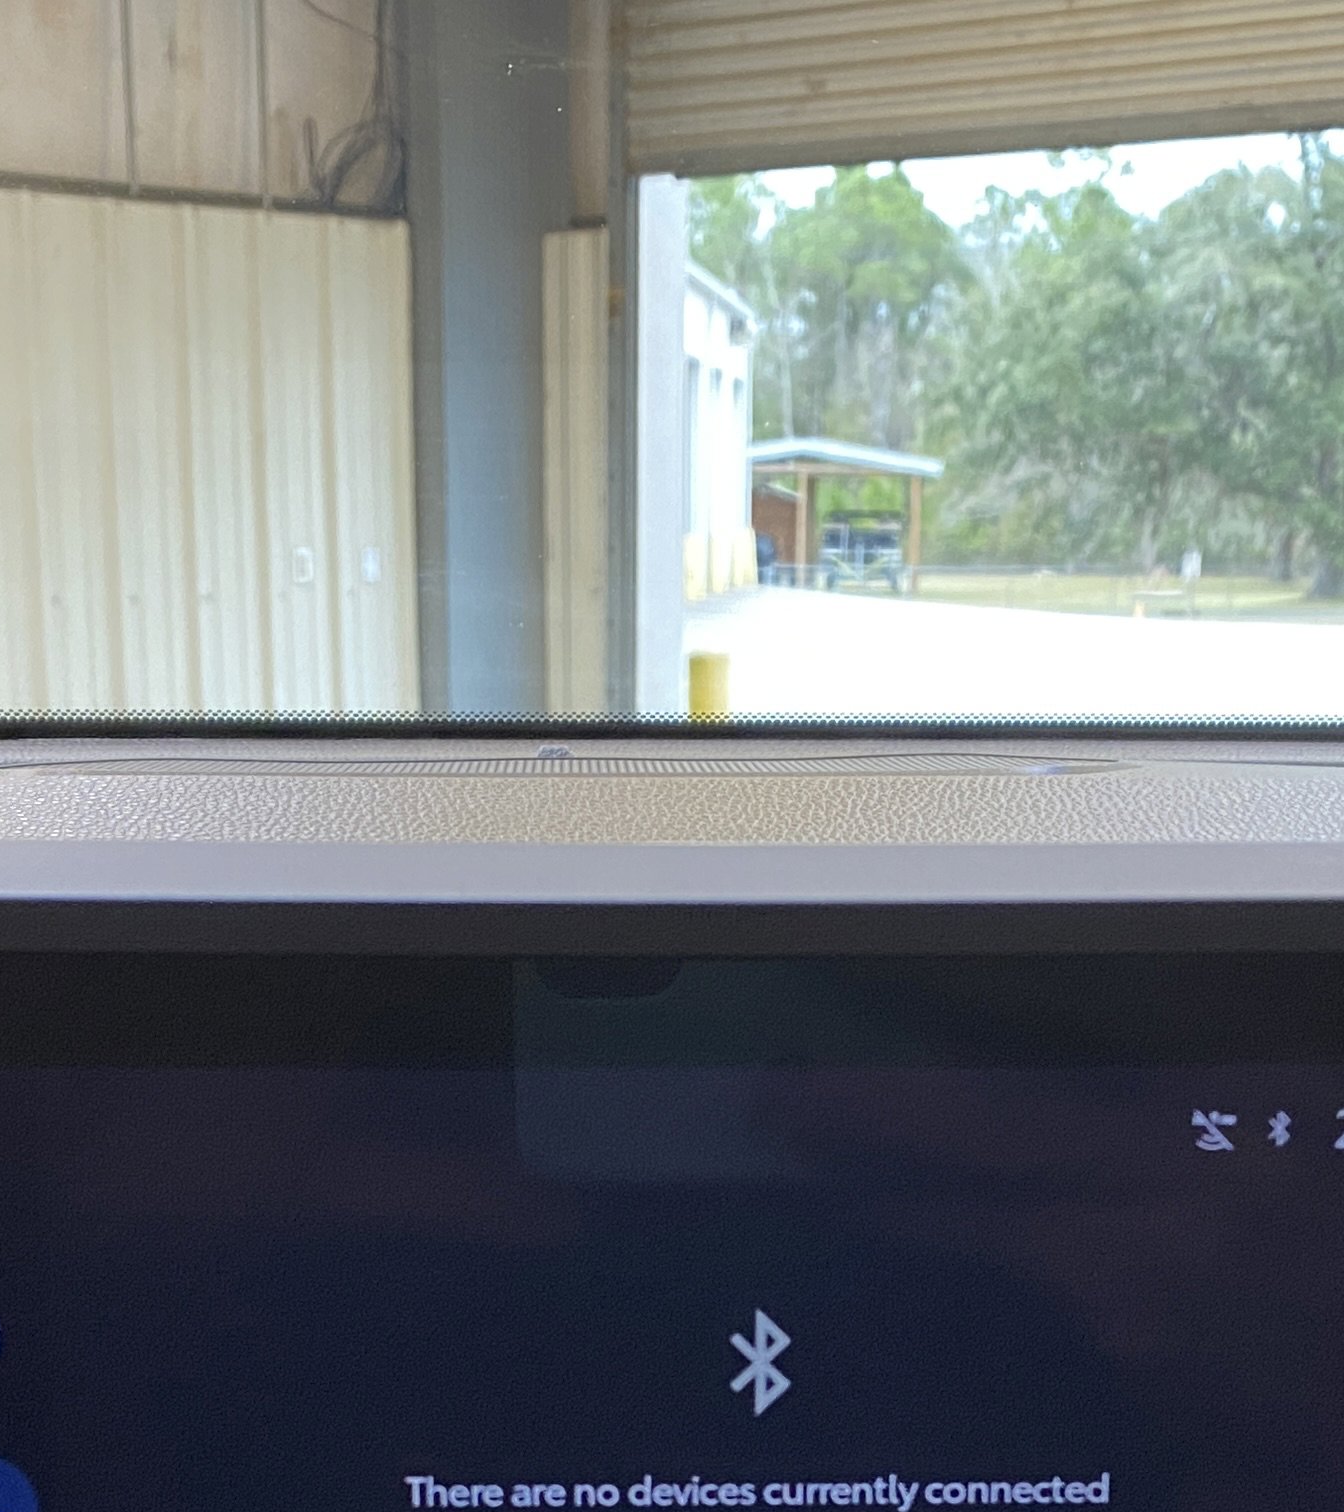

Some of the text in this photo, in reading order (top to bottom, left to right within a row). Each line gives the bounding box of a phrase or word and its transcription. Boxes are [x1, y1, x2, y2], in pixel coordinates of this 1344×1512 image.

[406, 1472, 1111, 1512] There are no devices currently connected
